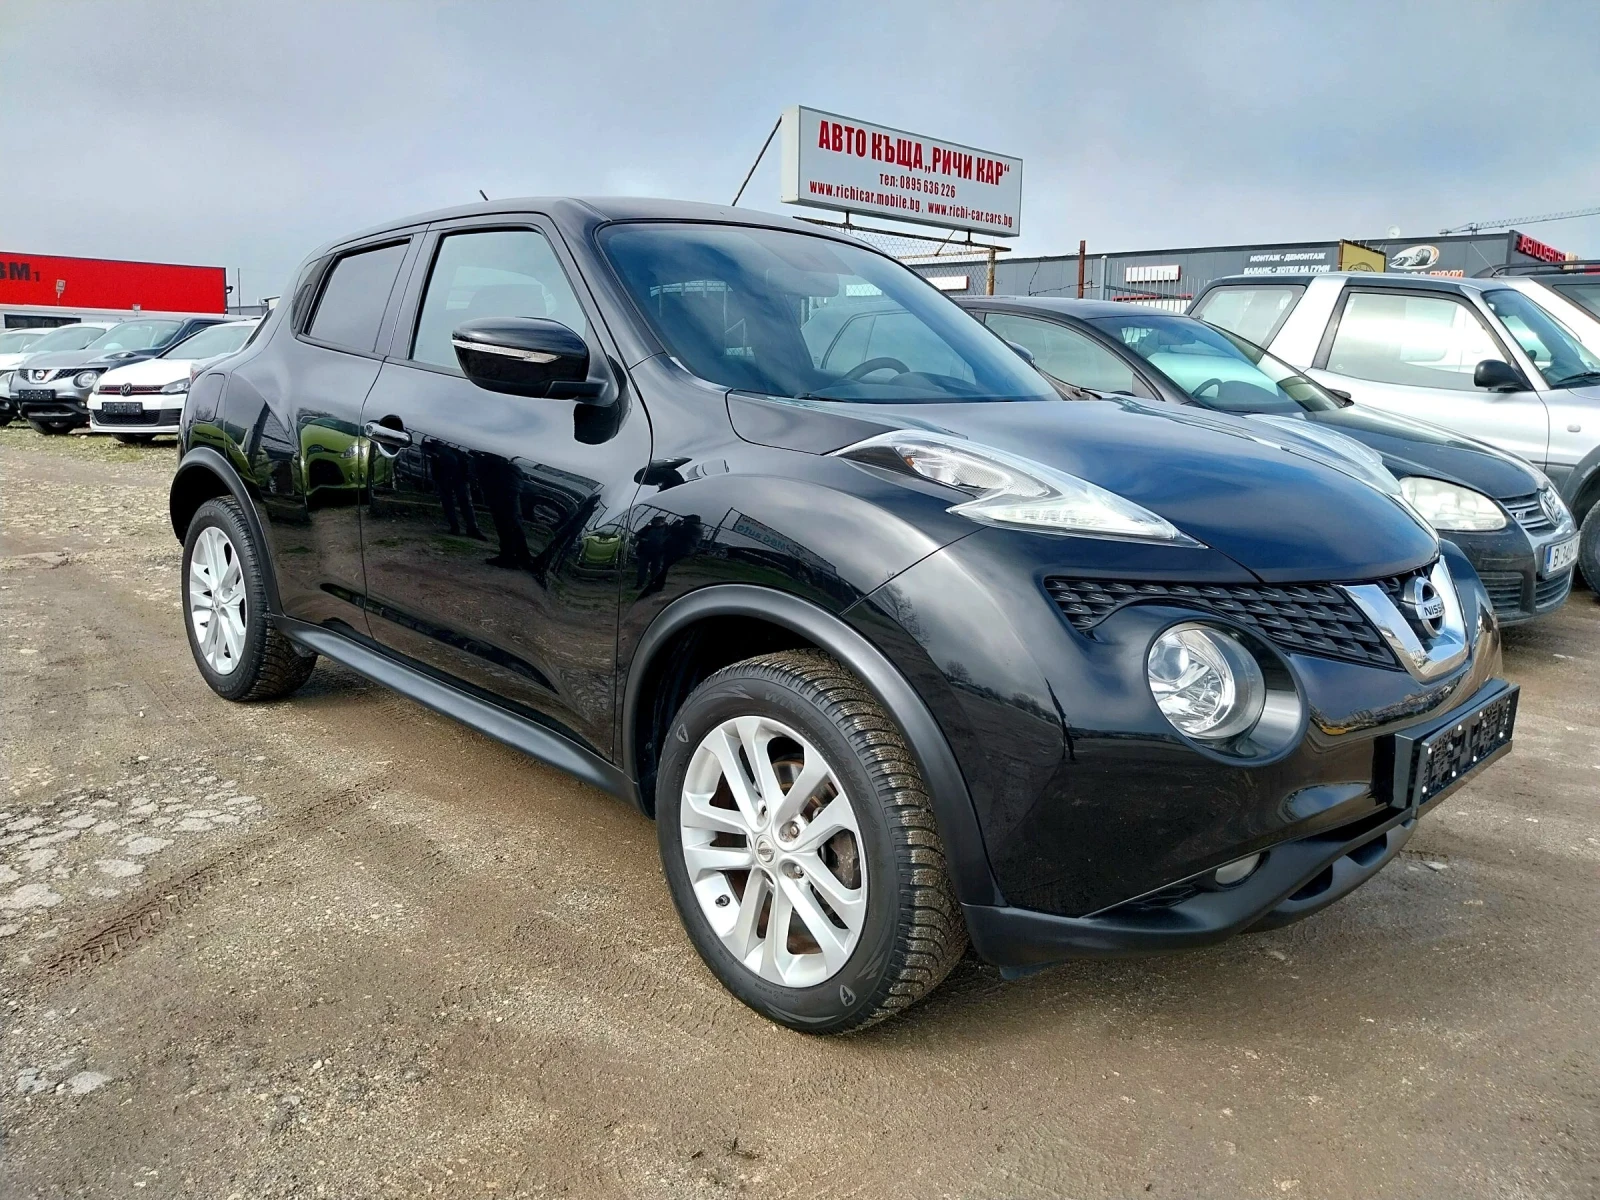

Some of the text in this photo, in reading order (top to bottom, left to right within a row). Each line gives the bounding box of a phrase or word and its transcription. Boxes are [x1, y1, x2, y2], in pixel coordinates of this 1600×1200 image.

[818, 119, 867, 158] АВТО
[871, 132, 923, 172] КЪЩА
[879, 173, 956, 199] тел: 0895 636 226
[928, 202, 1013, 228] www.richi-car.cars.bg
[1249, 252, 1326, 263] МОНТАЖ ДЕМОНТАЖ
[1423, 603, 1443, 616] NISS
